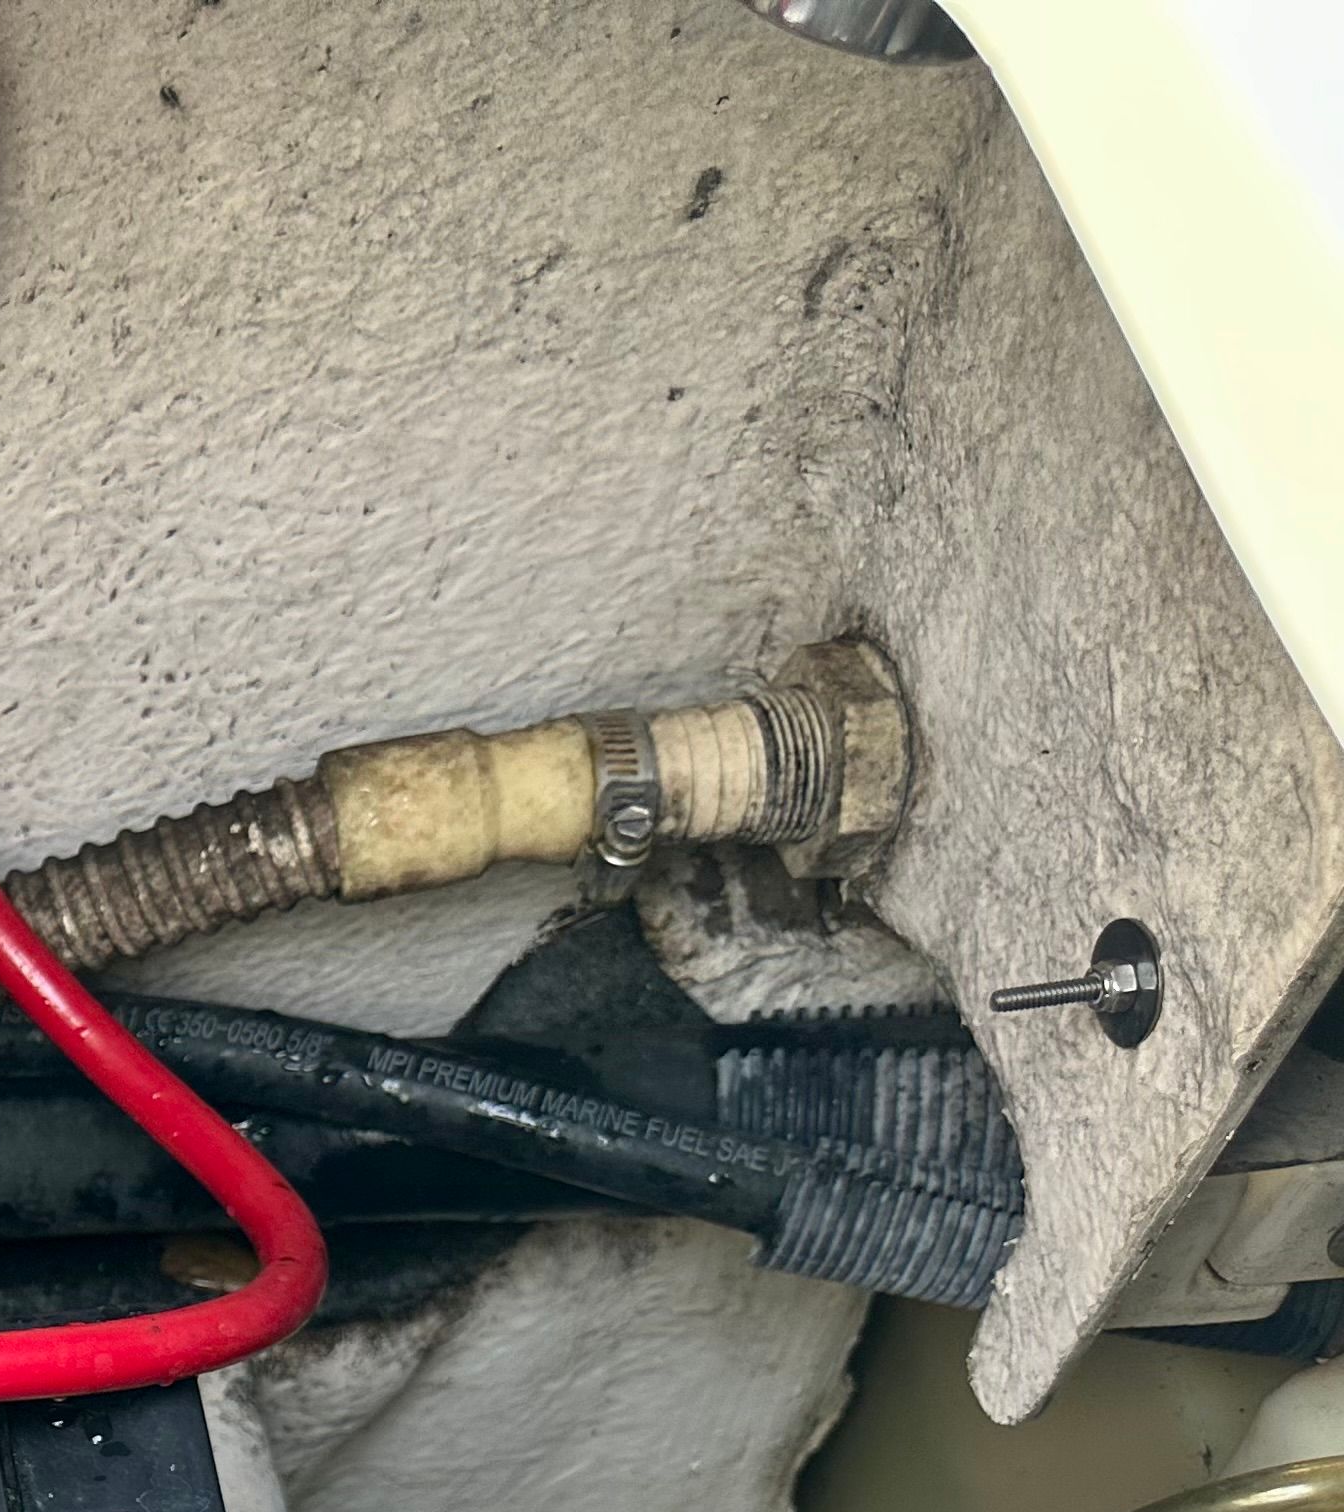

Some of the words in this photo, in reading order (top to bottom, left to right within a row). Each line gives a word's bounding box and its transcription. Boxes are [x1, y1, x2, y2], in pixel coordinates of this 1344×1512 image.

[175, 1008, 286, 1050] 350-0580
[367, 1046, 412, 1078] MPI
[416, 1058, 539, 1112] PREMIUM
[542, 1090, 640, 1137] MARINE
[645, 1119, 709, 1157] FUEL
[716, 1139, 768, 1173] SAE
